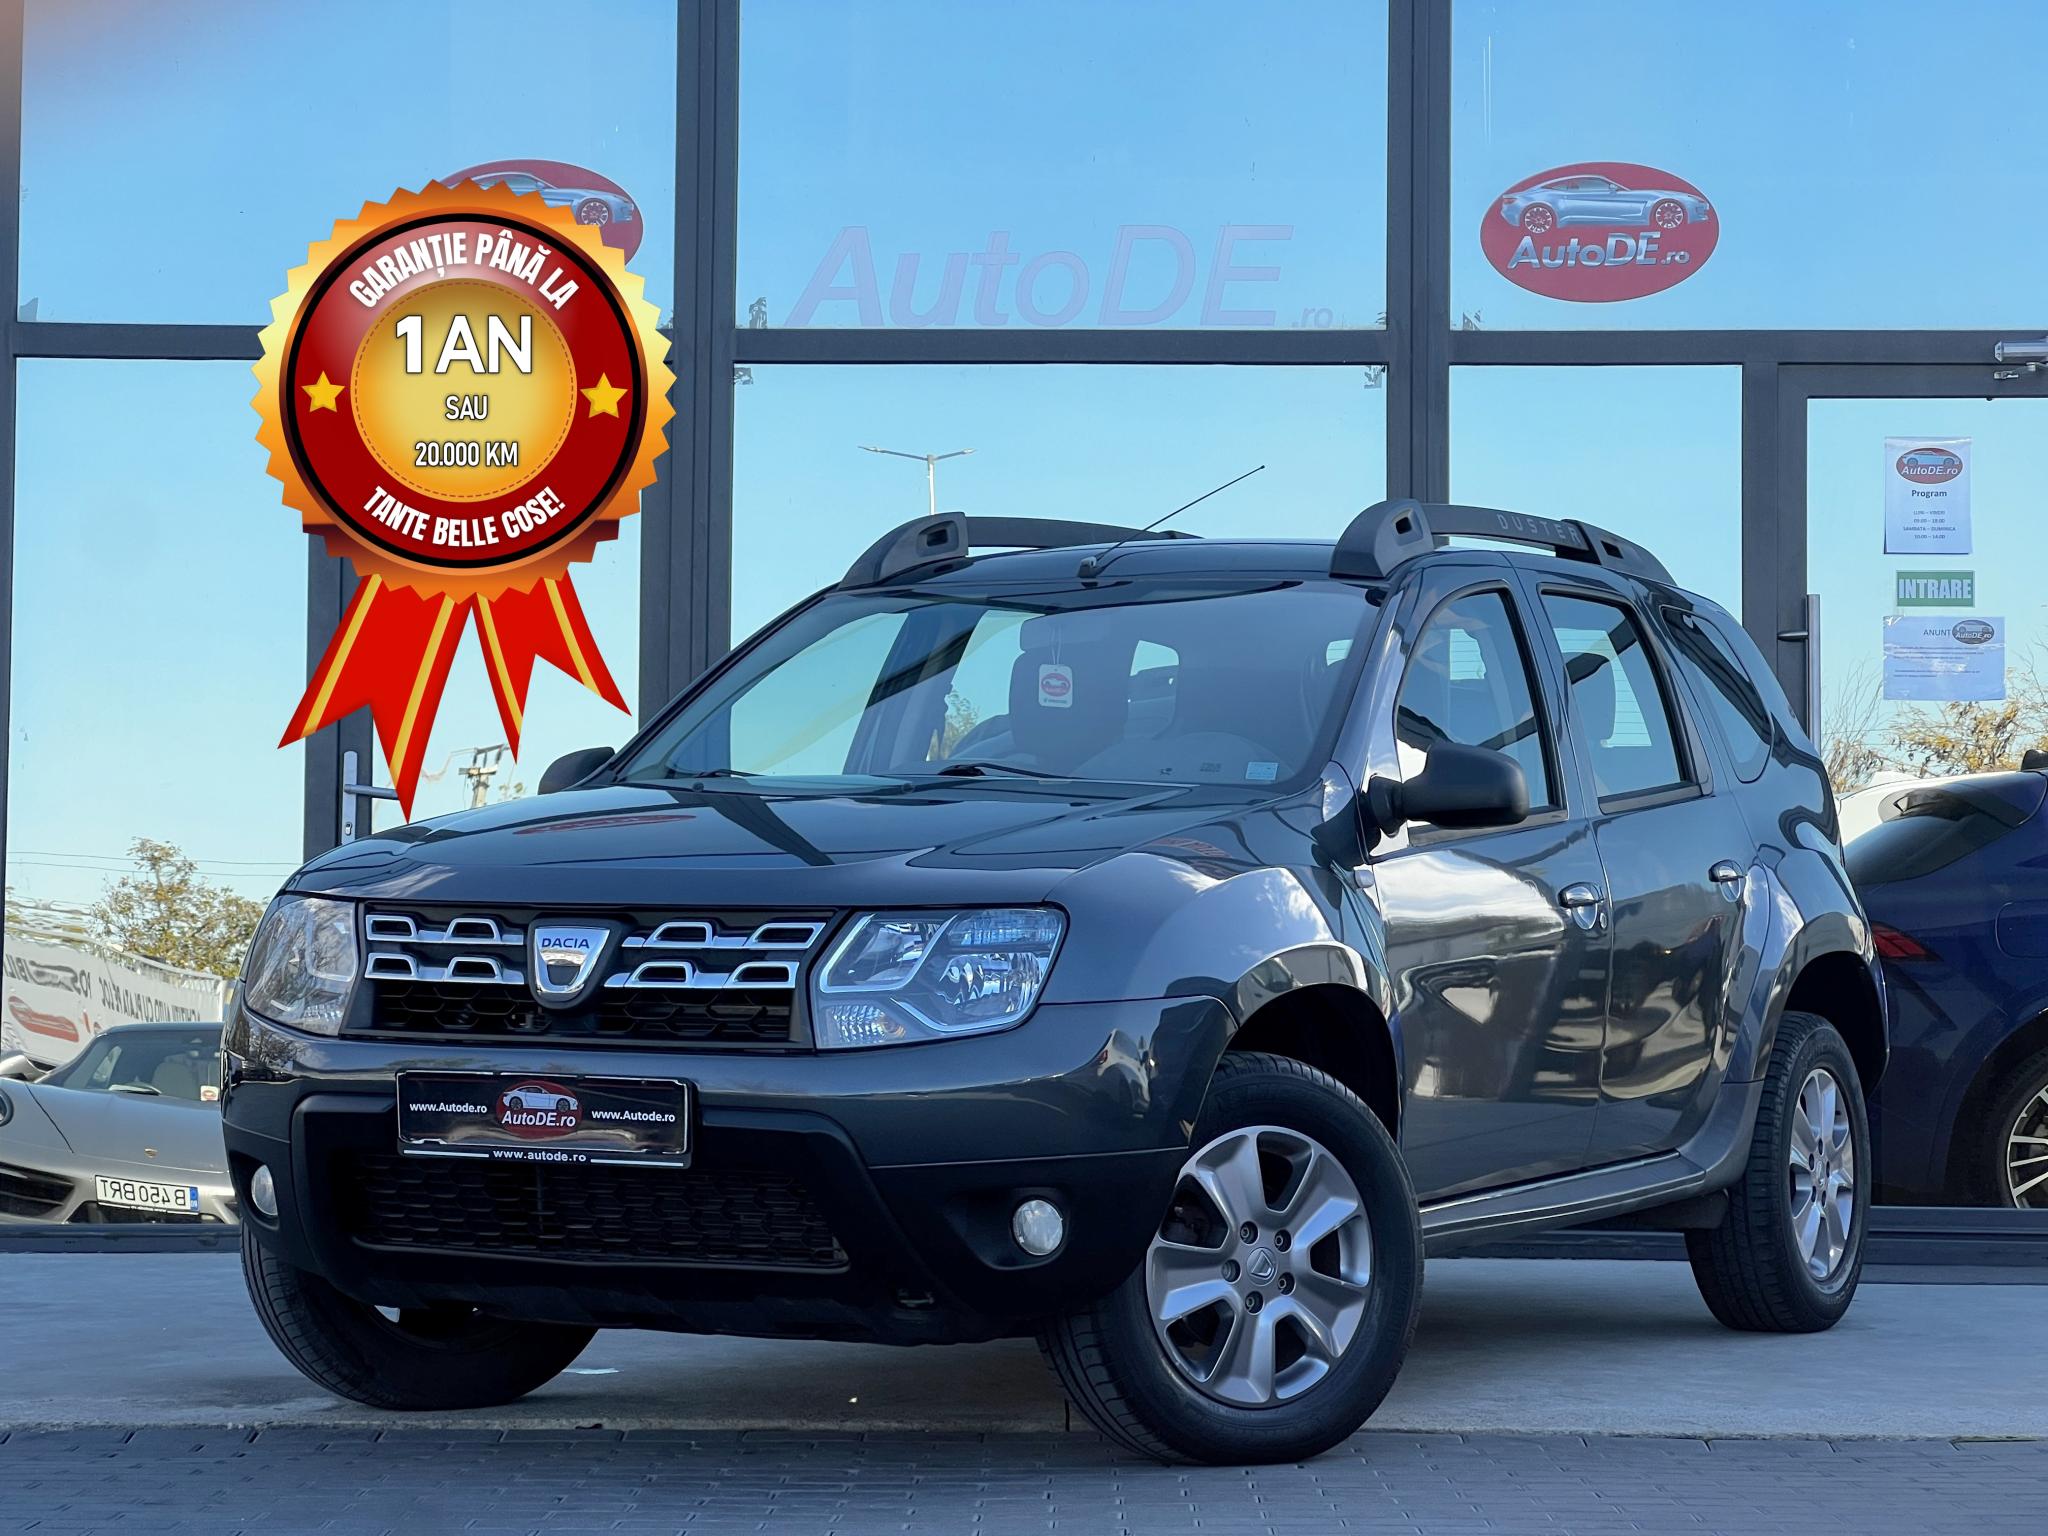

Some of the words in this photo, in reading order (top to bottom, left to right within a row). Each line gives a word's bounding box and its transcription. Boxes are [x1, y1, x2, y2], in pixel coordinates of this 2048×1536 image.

[1901, 466, 1958, 475] AutoDE.ro
[1911, 490, 1948, 498] Program
[1496, 513, 1581, 542] DUSTER
[1899, 578, 1972, 599] INTRARE
[541, 937, 590, 949] DACIA
[409, 1101, 488, 1114] www.Autode.ro
[501, 1110, 576, 1128] AutoDE.ro
[591, 1109, 676, 1122] www.Autode.ro
[493, 1149, 587, 1162] www.autode.ro
